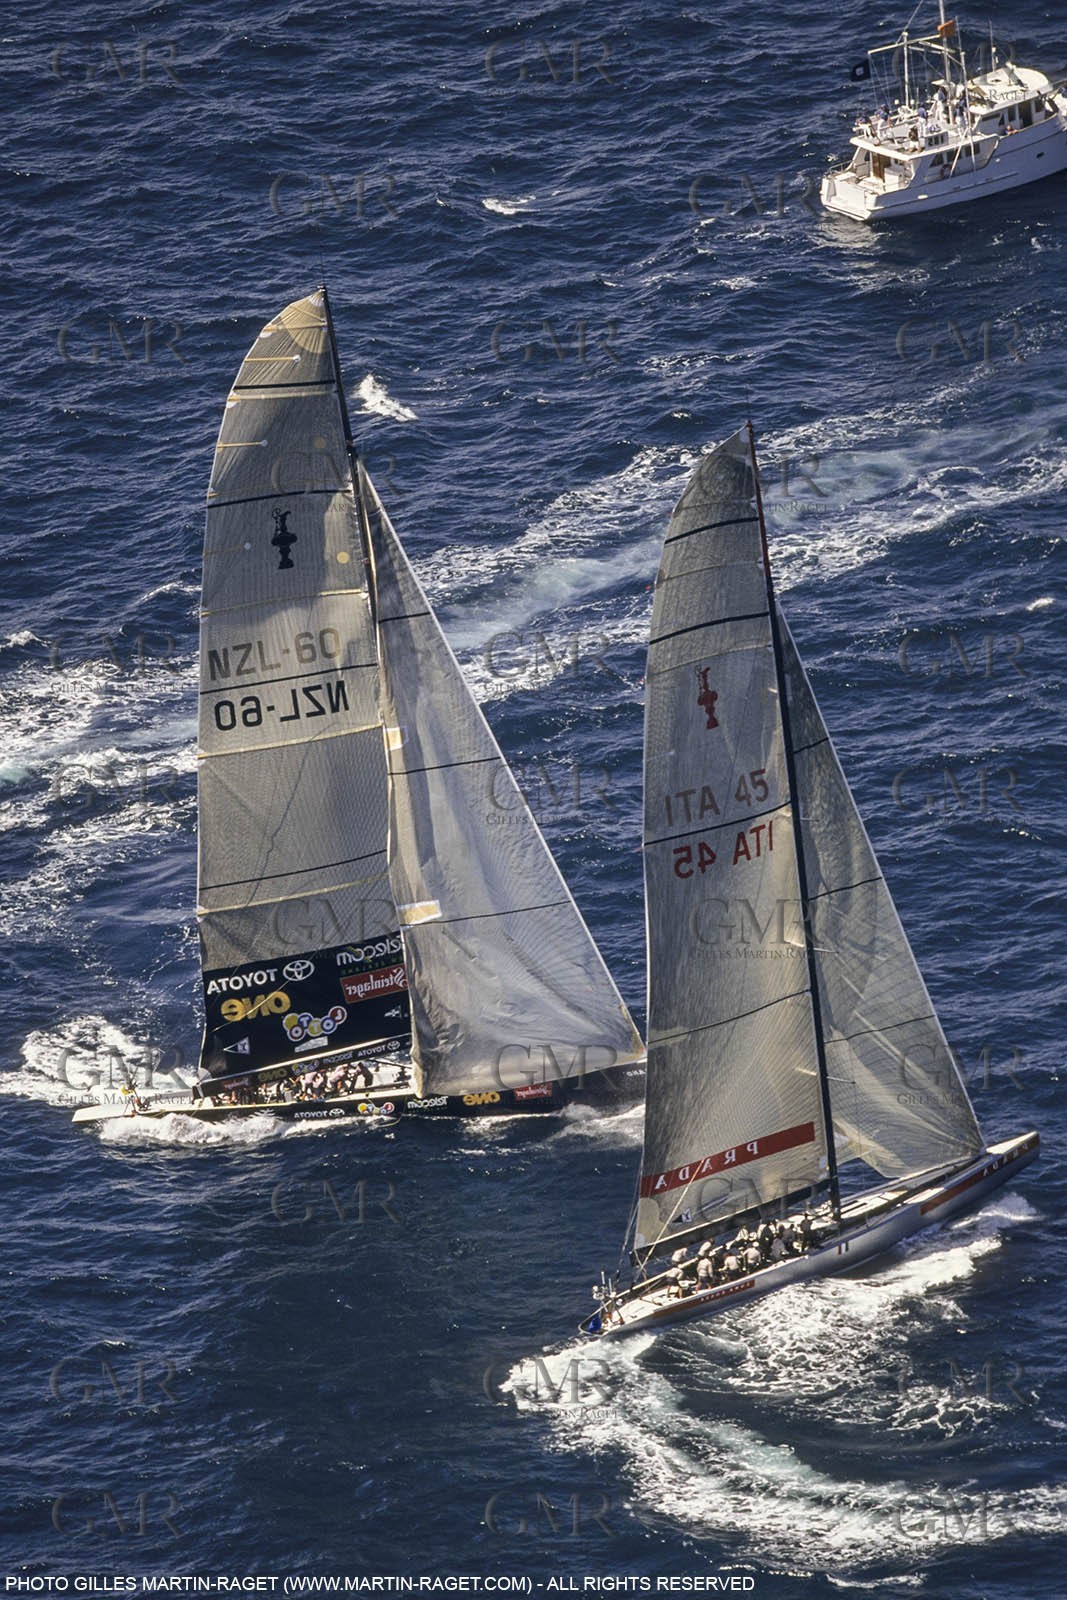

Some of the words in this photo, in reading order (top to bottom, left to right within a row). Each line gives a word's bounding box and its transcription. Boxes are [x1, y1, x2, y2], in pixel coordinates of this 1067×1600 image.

[208, 628, 340, 680] NZL-60
[665, 785, 720, 827] ITA
[735, 769, 769, 806] 45
